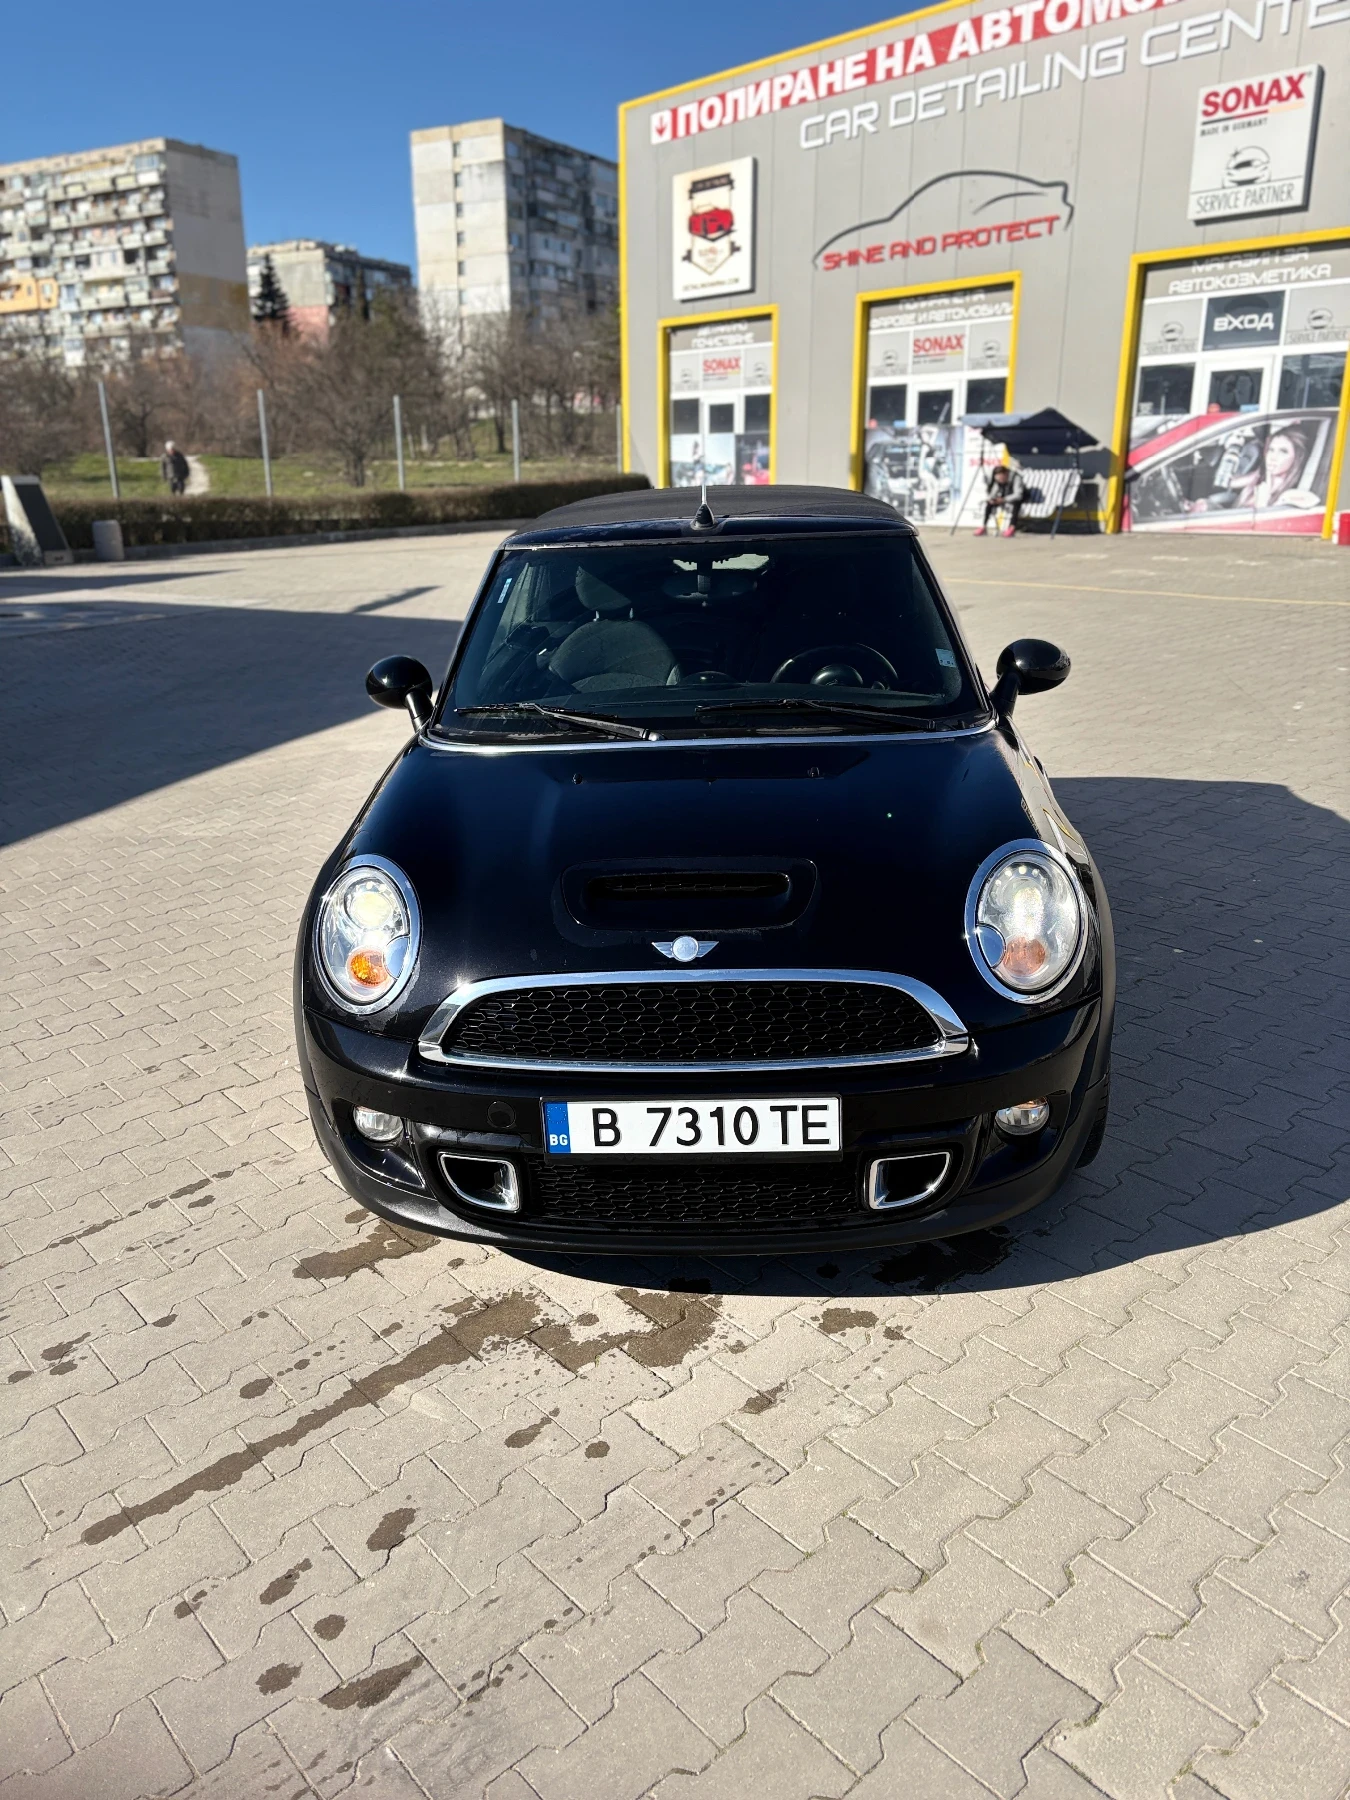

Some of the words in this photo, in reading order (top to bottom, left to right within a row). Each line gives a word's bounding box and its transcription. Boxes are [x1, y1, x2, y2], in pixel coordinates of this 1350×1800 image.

[676, 51, 868, 138] ПОЛИРАНЕ
[875, 32, 936, 82] НА
[947, 0, 1183, 62] АВТОМ
[800, 100, 880, 149] CAR
[889, 36, 1127, 128] DETAILING
[1202, 72, 1306, 118] SONAX
[1195, 190, 1241, 214] SERVICE
[1243, 182, 1295, 206] PARTNER
[823, 244, 884, 271] SHINE
[889, 236, 936, 260] AND
[942, 215, 1060, 251] PROTECT
[1168, 263, 1331, 295] АВТОКОЗМЕТИКА
[1213, 312, 1275, 332] ВХОД
[913, 334, 964, 354] SONAX
[703, 357, 741, 373] SONAX
[549, 1133, 568, 1146] BG
[592, 1107, 622, 1147] B
[646, 1105, 760, 1147] 7310
[769, 1104, 830, 1145] TE
